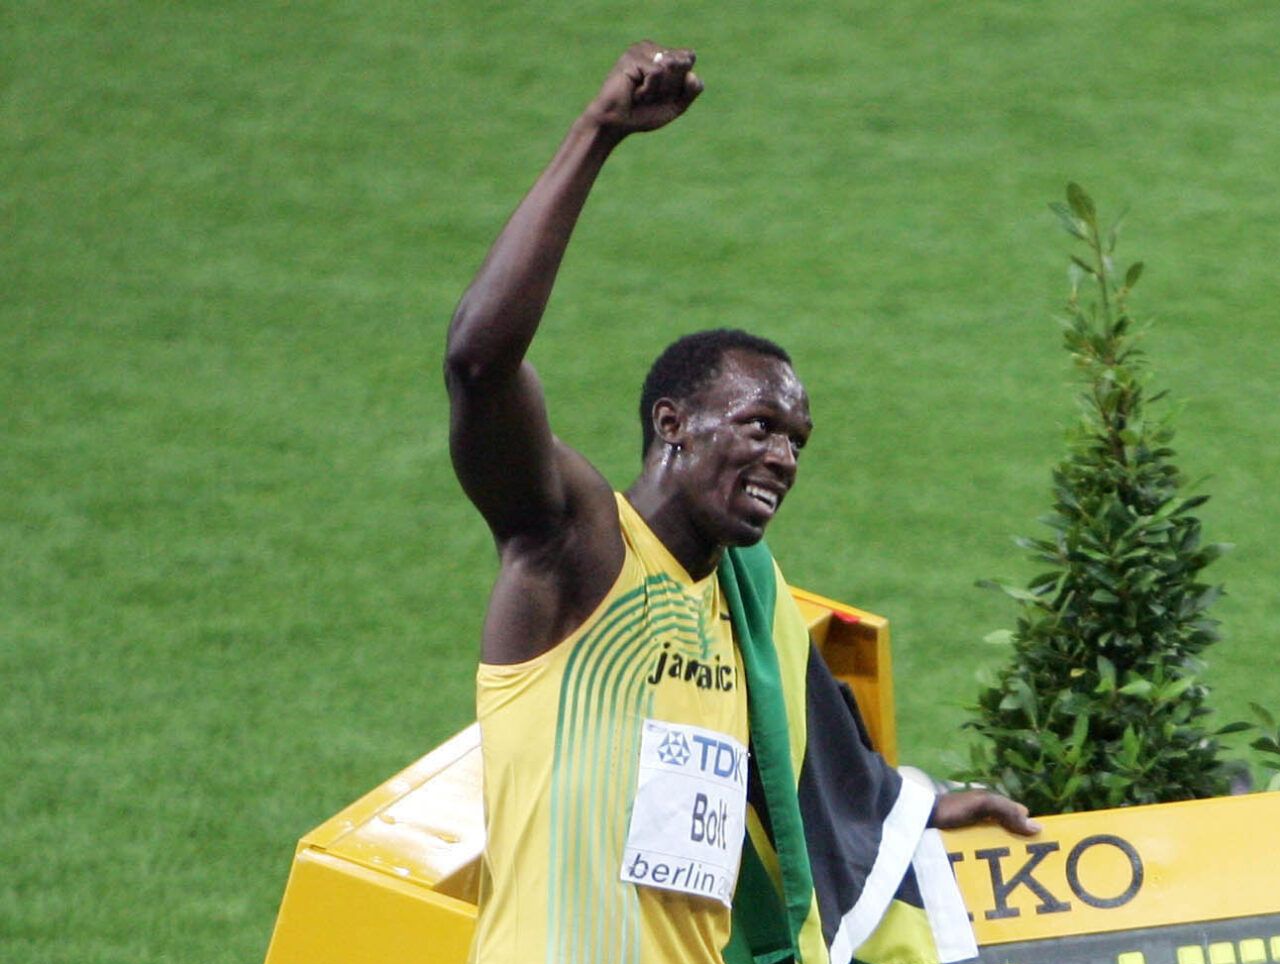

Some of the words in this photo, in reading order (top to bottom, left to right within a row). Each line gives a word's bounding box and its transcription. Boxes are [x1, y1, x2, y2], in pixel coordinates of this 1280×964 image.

[648, 642, 738, 691] jamaic
[692, 734, 744, 786] TDK
[690, 793, 727, 850] Bolt
[628, 853, 715, 893] berlin
